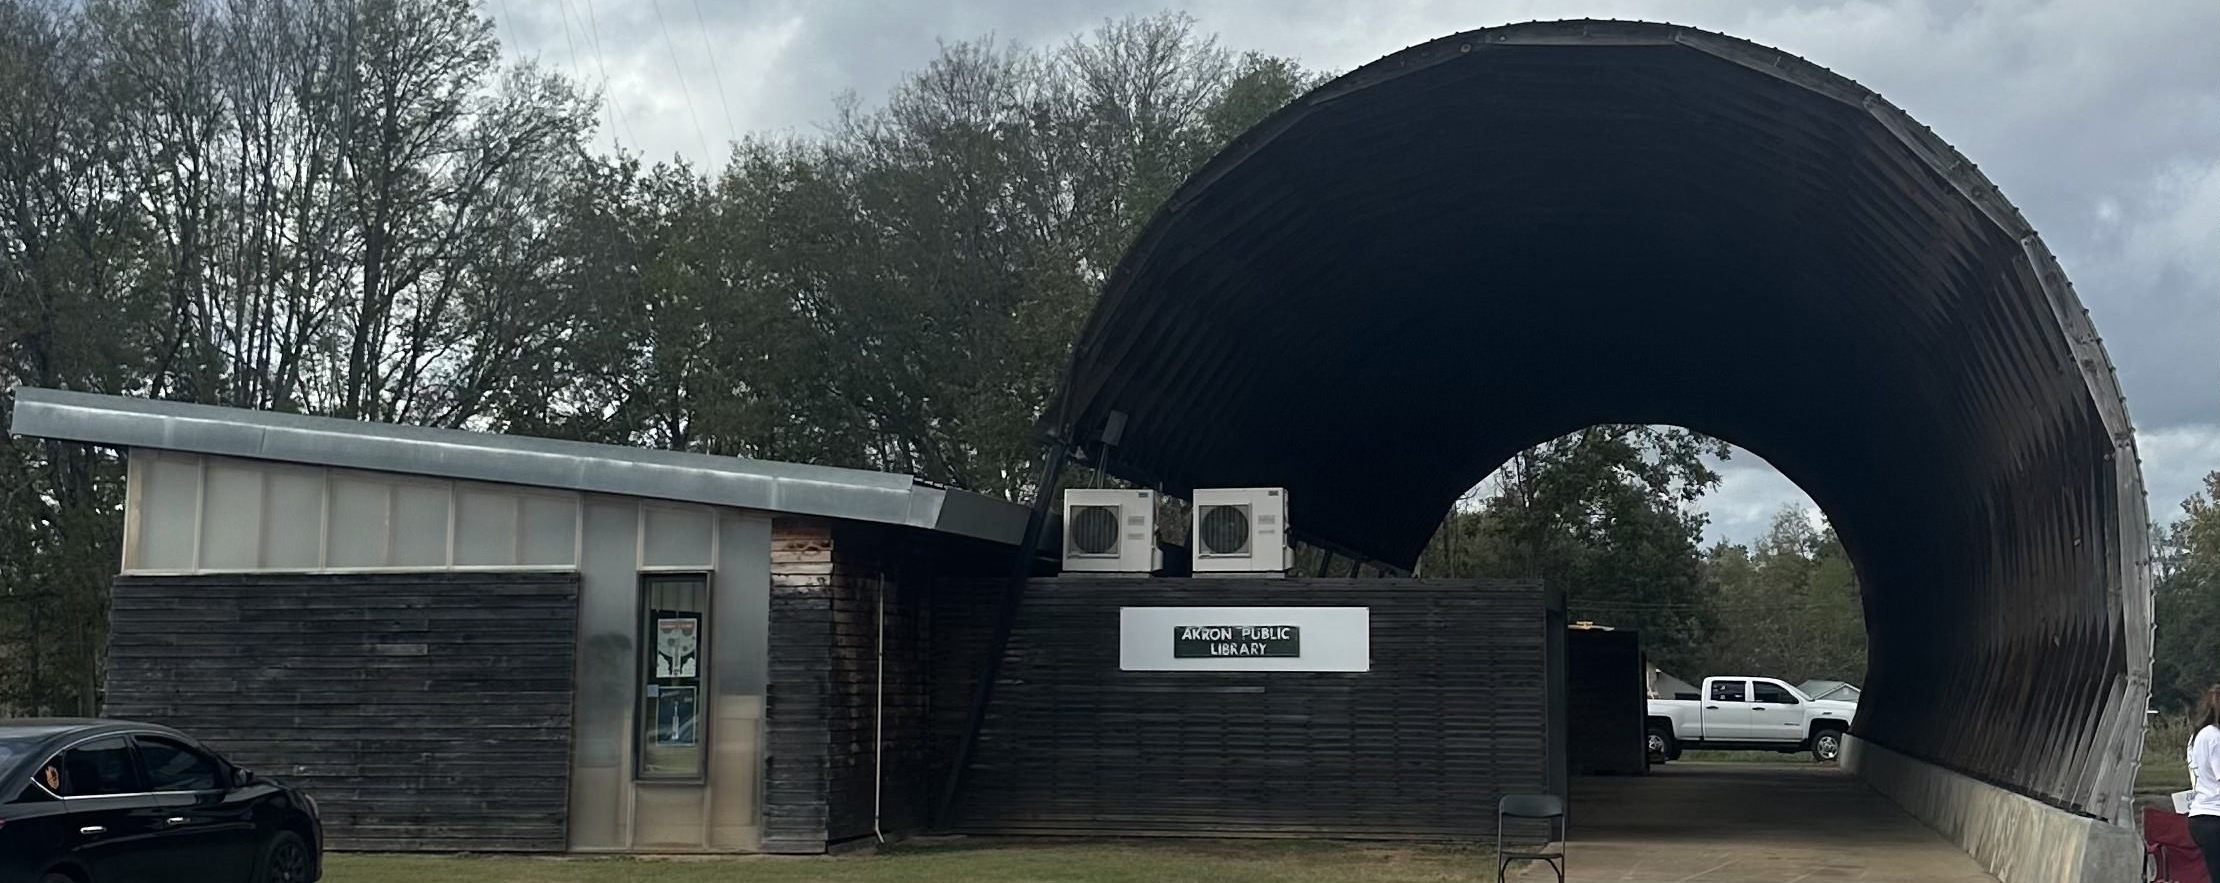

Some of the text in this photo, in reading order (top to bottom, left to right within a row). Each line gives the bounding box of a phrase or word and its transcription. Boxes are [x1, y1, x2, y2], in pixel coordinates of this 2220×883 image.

[1182, 627, 1290, 640] AKRON PUBLIC
[1210, 642, 1267, 656] LIBRARY
